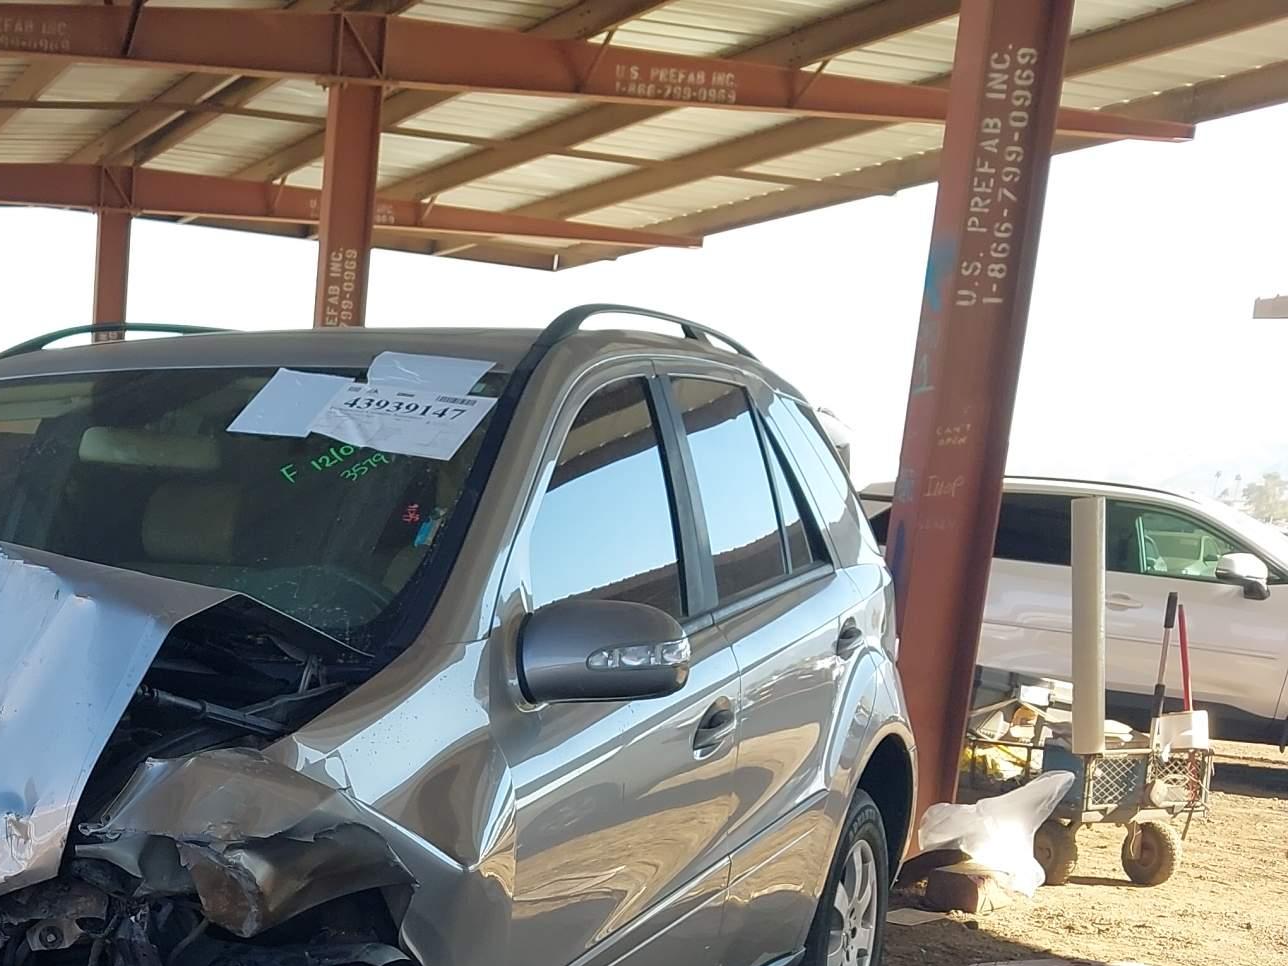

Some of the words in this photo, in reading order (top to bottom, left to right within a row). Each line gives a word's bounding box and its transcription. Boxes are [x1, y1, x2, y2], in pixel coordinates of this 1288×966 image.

[649, 67, 706, 85] PREFAB
[985, 43, 1013, 100] INC.
[615, 81, 737, 103] 1-866-799-0969
[966, 117, 1002, 233] PREFAB
[982, 46, 1038, 304] 1-866-799-0969
[330, 247, 344, 277] INC.
[955, 252, 984, 306] U.S.
[343, 396, 467, 421] 43939147
[280, 464, 297, 483] F
[340, 453, 390, 481] 3579
